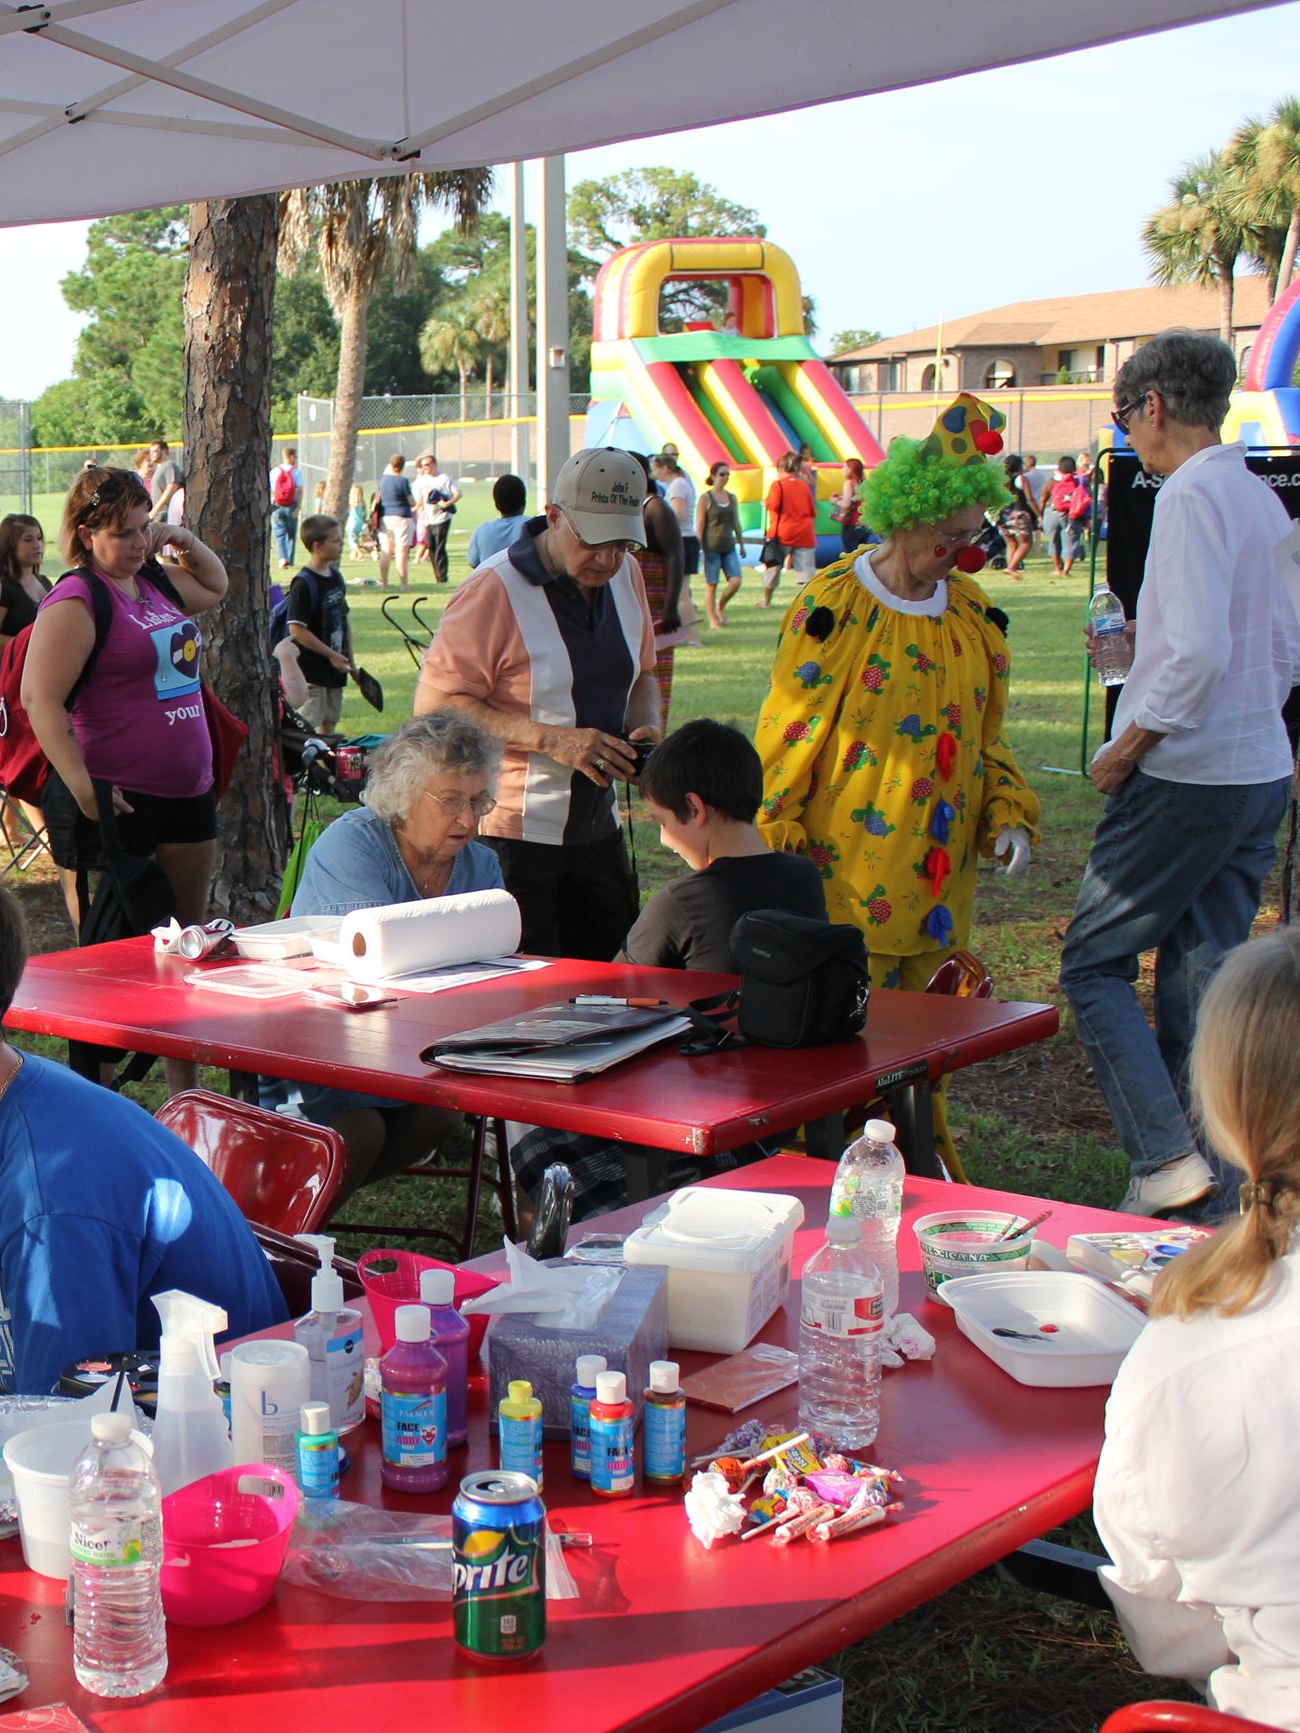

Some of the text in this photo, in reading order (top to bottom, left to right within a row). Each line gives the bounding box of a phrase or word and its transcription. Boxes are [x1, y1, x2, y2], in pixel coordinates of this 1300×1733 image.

[165, 704, 201, 726] your
[396, 1421, 420, 1433] FACE
[396, 1435, 421, 1446] BODY
[452, 1545, 528, 1596] prite
